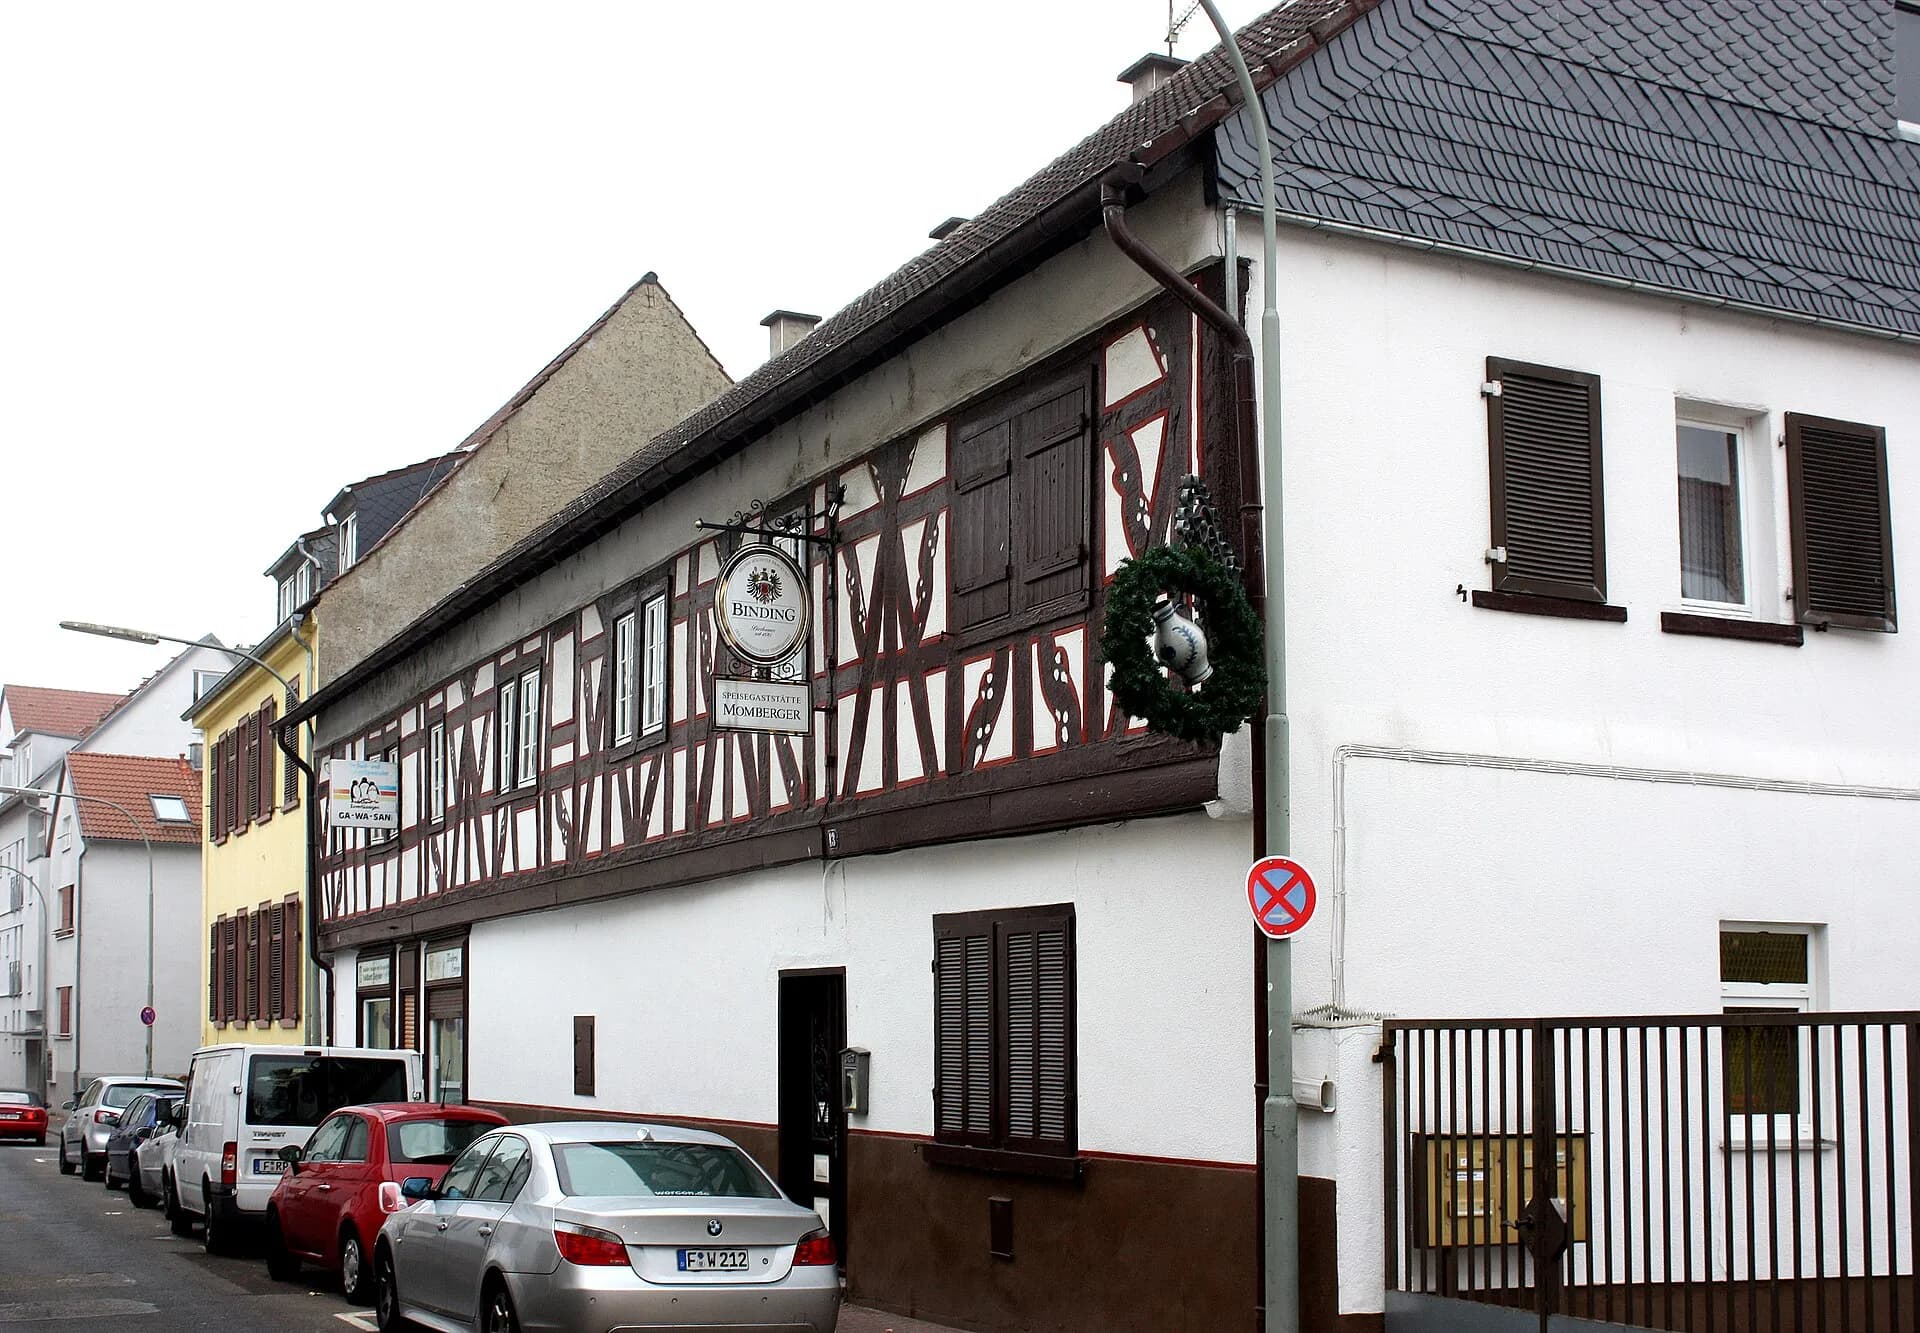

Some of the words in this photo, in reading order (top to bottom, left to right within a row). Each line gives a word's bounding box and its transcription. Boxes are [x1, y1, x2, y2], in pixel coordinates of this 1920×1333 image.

[732, 602, 796, 622] BINDING
[722, 691, 801, 704] SPEISEGASTSTÄTTE
[723, 703, 801, 721] MOMBERGER
[720, 1252, 748, 1268] 212
